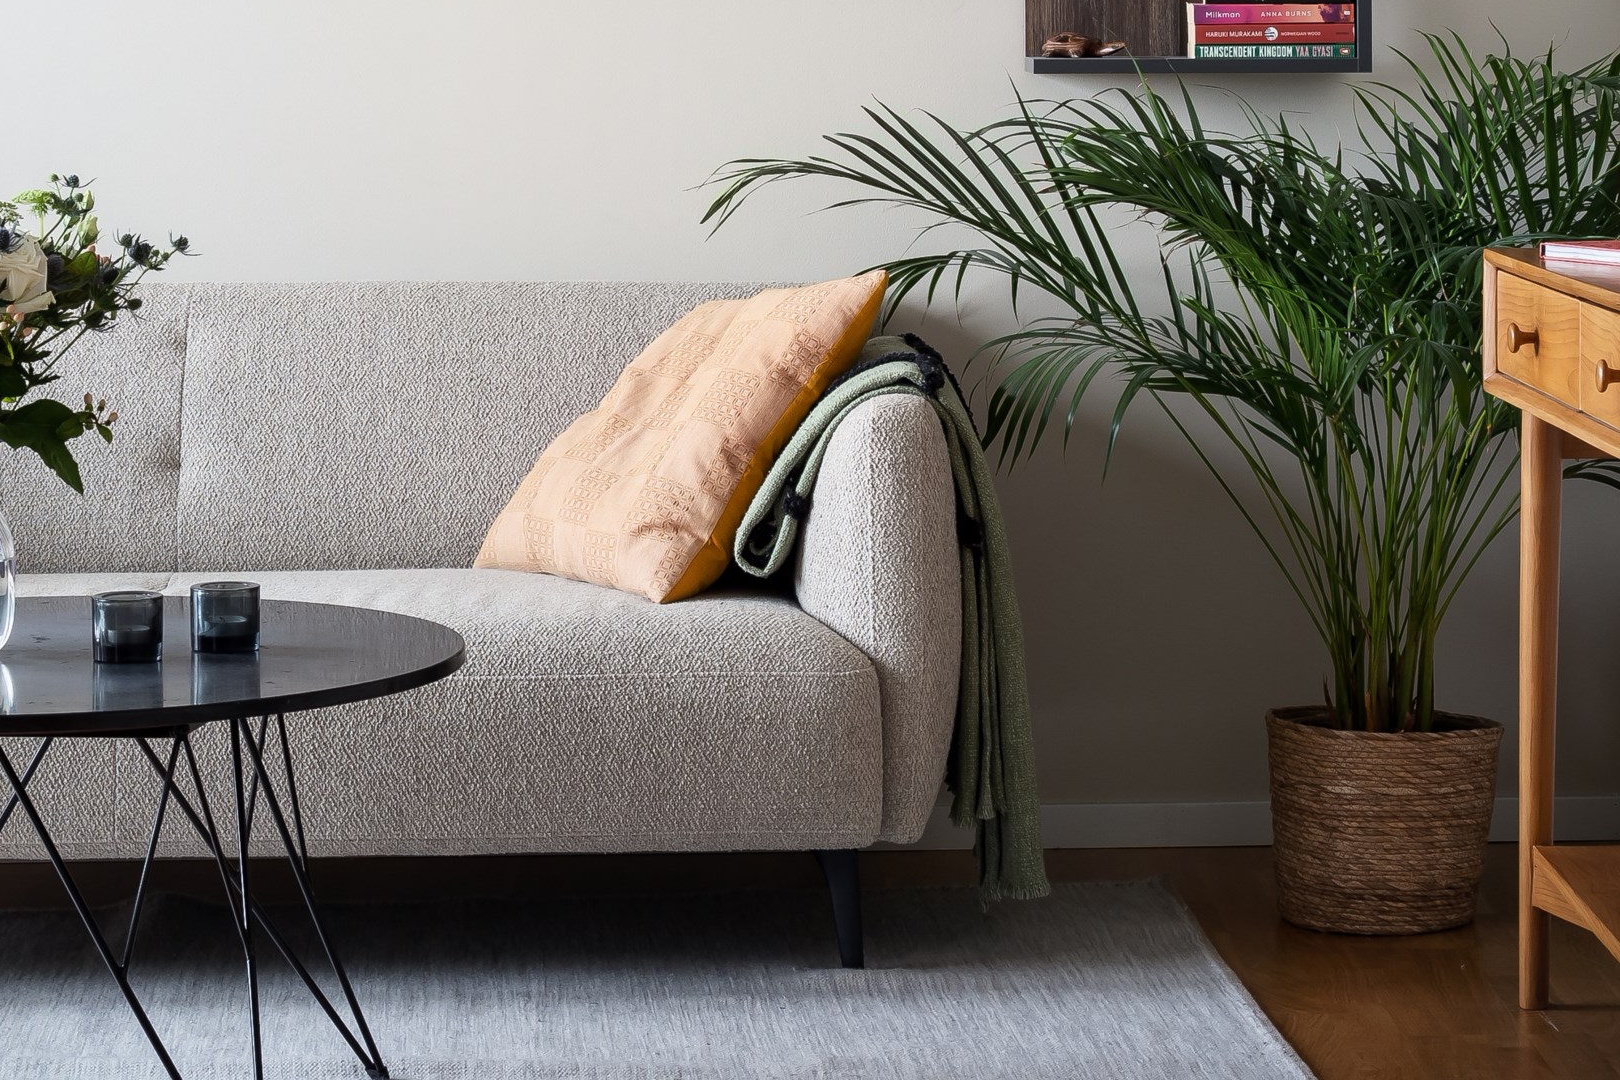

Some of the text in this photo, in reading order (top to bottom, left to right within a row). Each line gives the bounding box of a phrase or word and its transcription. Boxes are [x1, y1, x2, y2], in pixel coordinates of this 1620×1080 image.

[1205, 11, 1241, 19] Milkman
[1229, 30, 1262, 38] MURAKAMI
[1200, 46, 1333, 58] TRANSCENDENT KINGDOM YAA GYASI
